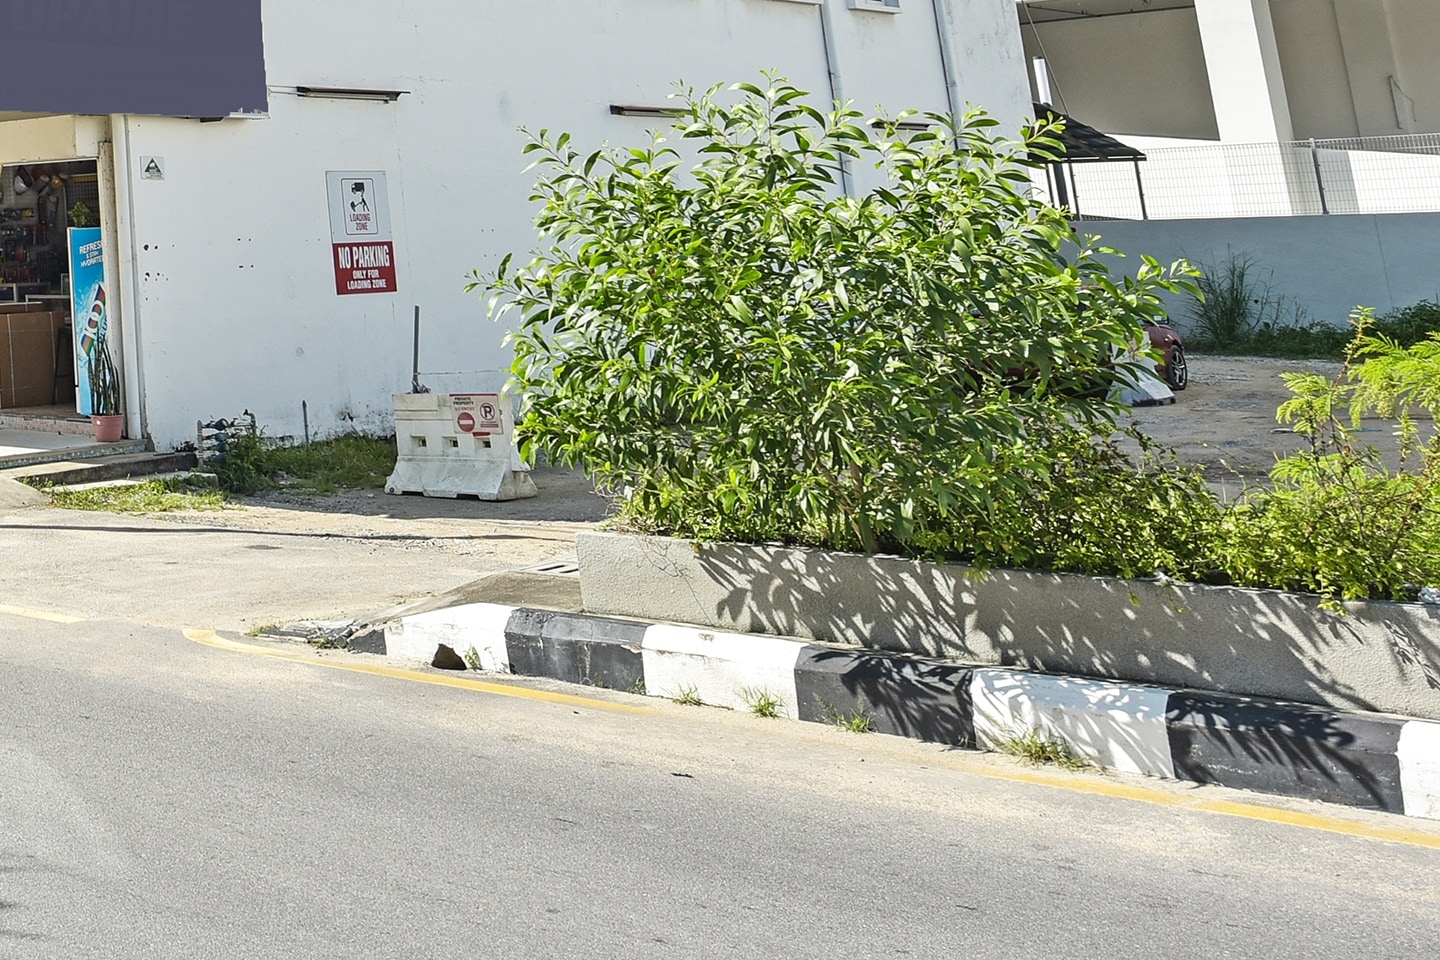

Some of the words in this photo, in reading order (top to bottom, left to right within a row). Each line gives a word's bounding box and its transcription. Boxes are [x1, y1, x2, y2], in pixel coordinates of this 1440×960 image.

[350, 213, 371, 222] LOADING
[355, 222, 369, 231] ZONE
[79, 240, 102, 255] REFRES
[338, 246, 351, 269] NO
[352, 245, 390, 268] PARKING
[352, 270, 366, 279] ONLY
[367, 269, 379, 279] FOR
[347, 280, 372, 290] LOADING
[372, 279, 387, 288] ZONE
